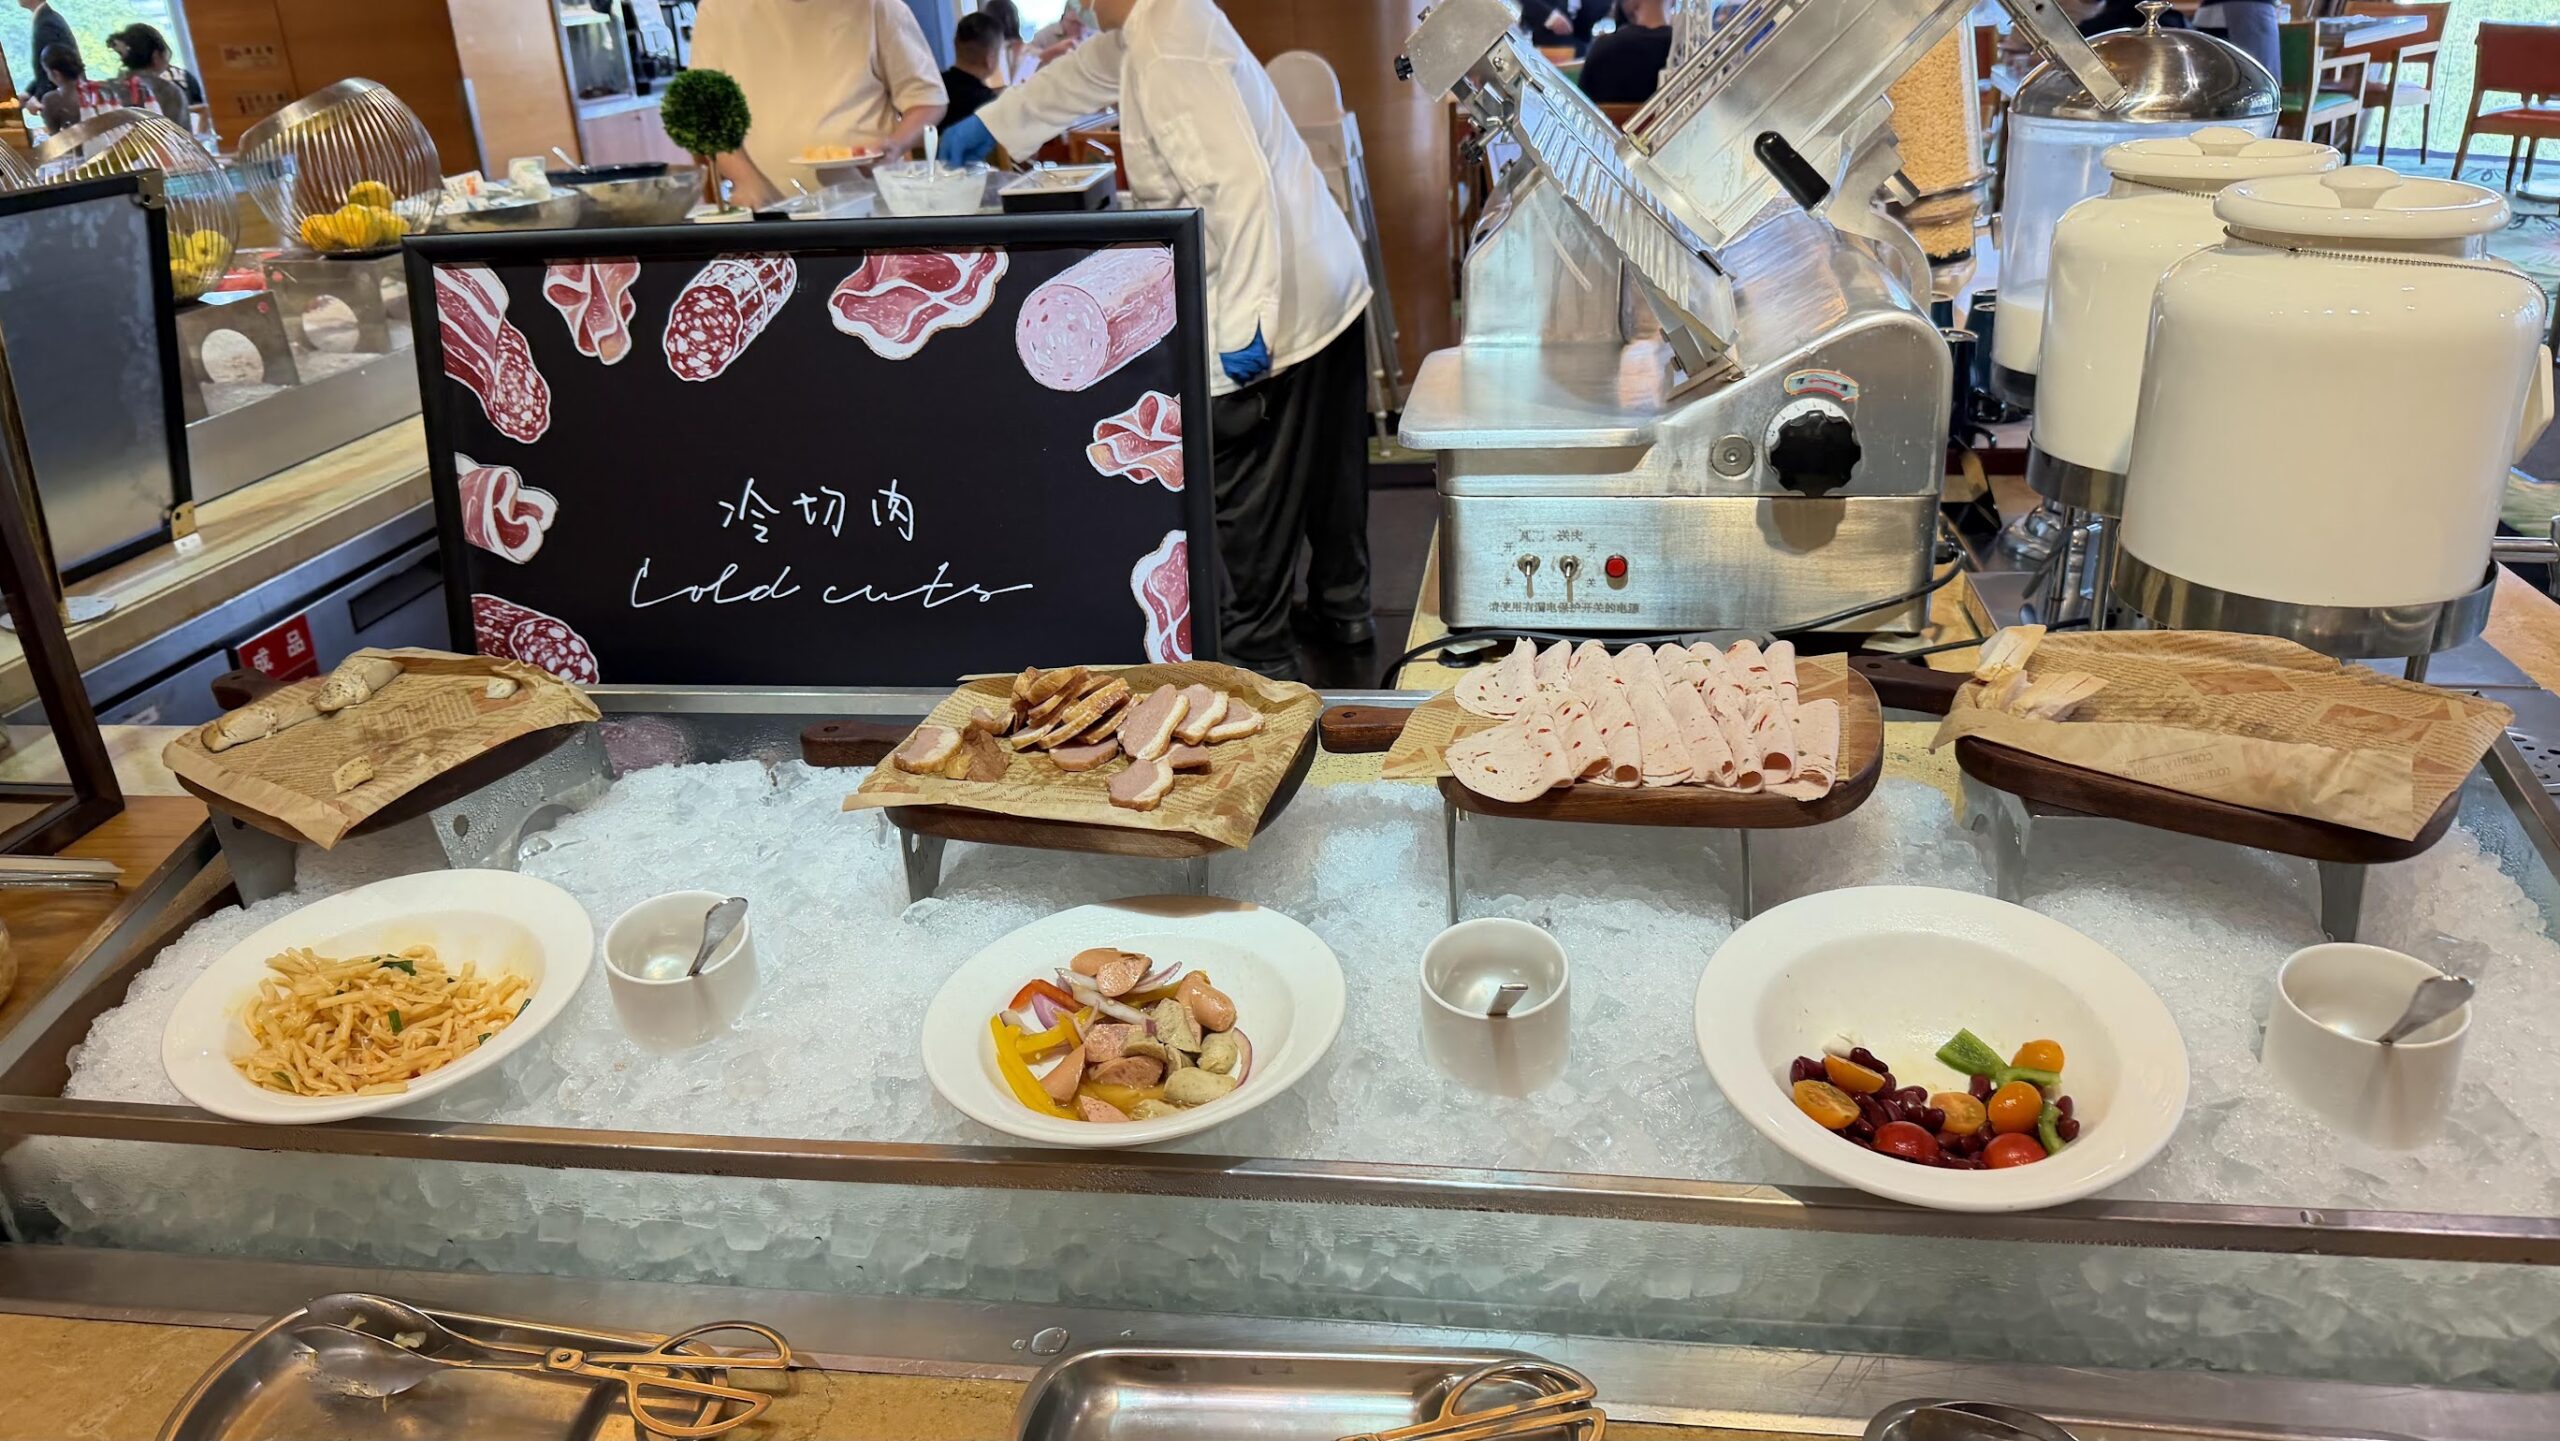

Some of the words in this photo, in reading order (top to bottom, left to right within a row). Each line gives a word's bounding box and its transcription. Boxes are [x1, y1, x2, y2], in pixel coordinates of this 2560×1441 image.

[719, 478, 914, 543] 冷切肉
[631, 557, 801, 608] Cold
[823, 562, 1034, 608] cuts
